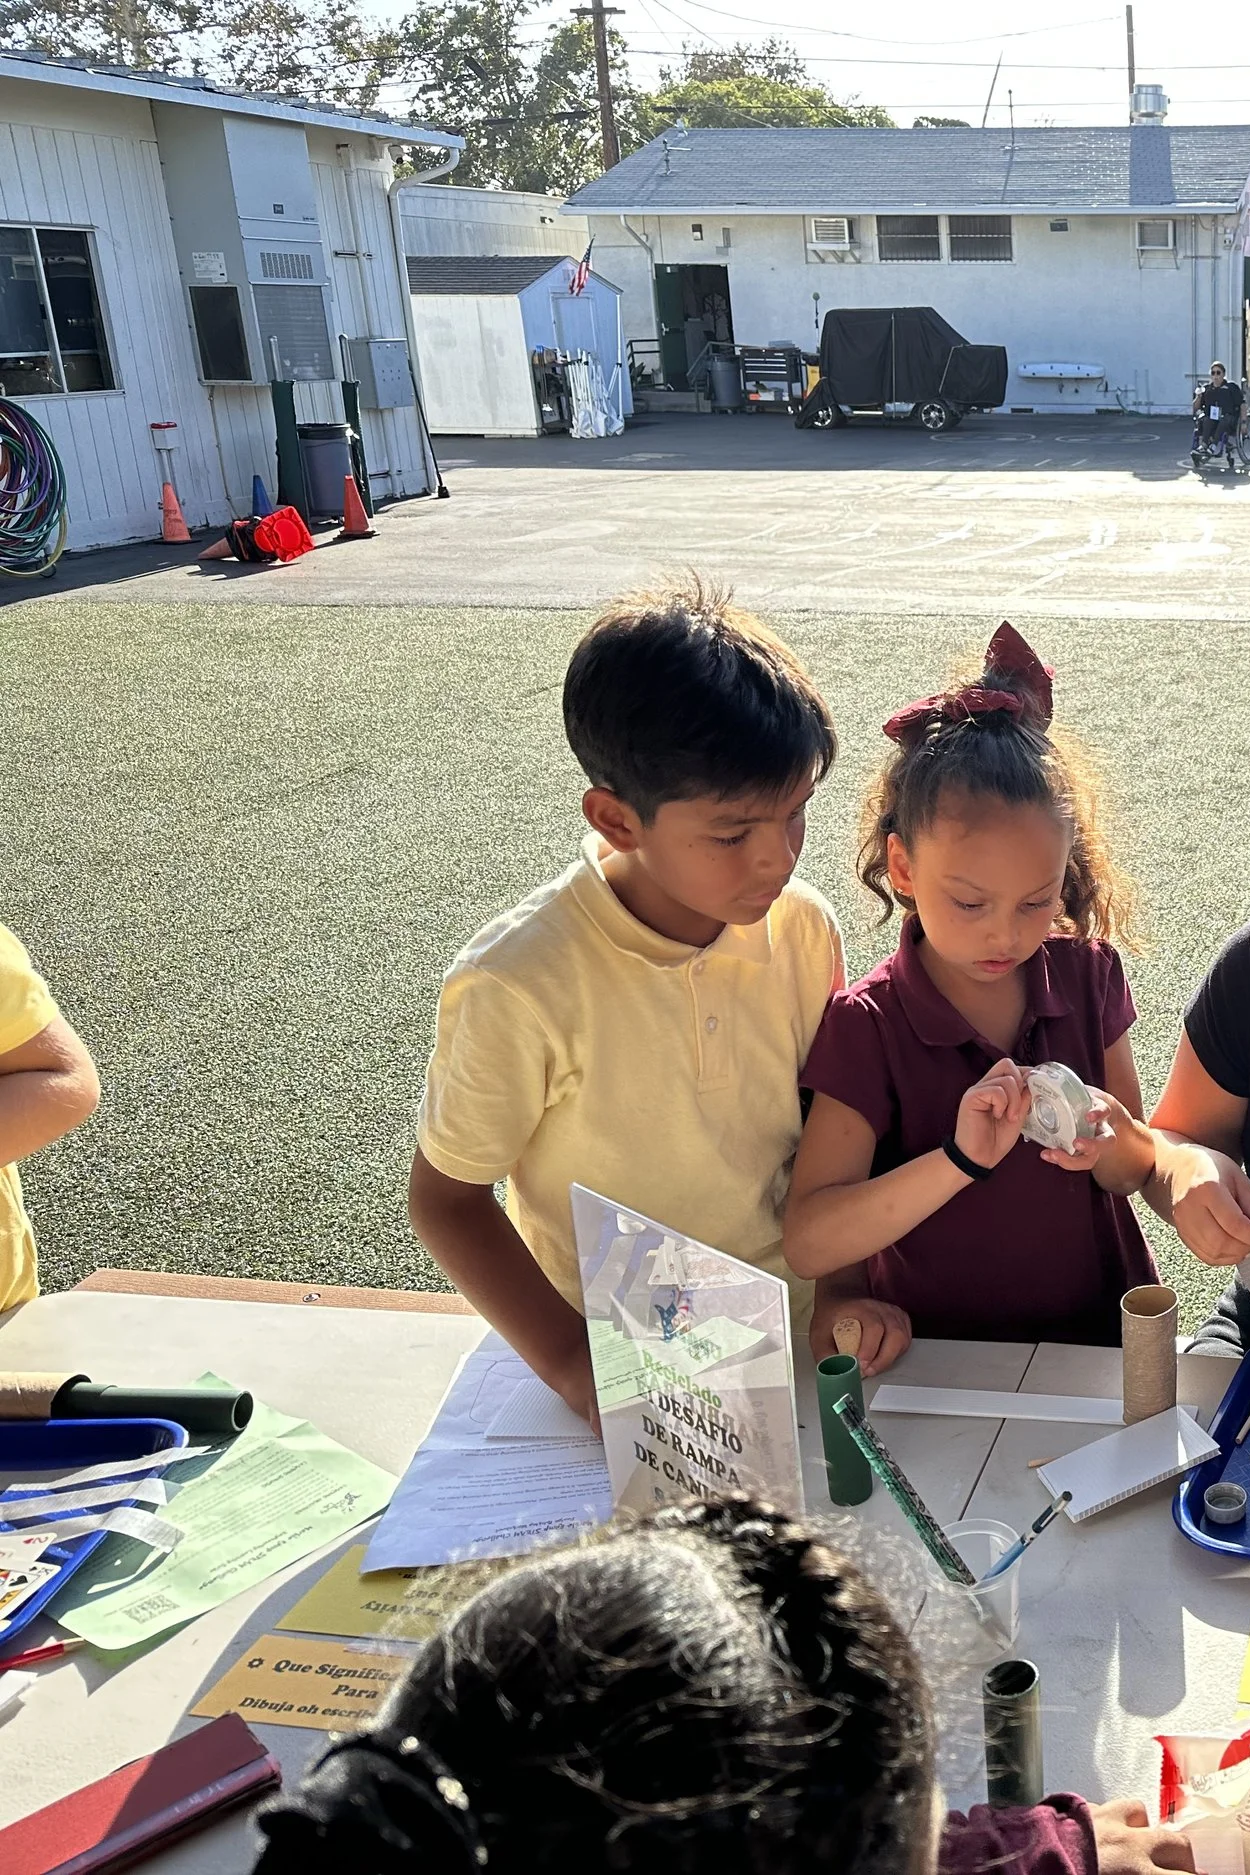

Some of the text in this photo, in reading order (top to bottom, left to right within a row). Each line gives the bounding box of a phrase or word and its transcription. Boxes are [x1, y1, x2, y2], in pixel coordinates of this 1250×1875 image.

[657, 1393, 743, 1454] DESAFIO
[634, 1441, 660, 1472] DE
[642, 1414, 668, 1445] DE
[670, 1431, 742, 1490] RAMPA
[272, 1659, 312, 1673] Que
[332, 1684, 378, 1699] Para
[239, 1696, 295, 1713] Dibuja
[297, 1704, 317, 1714] oh
